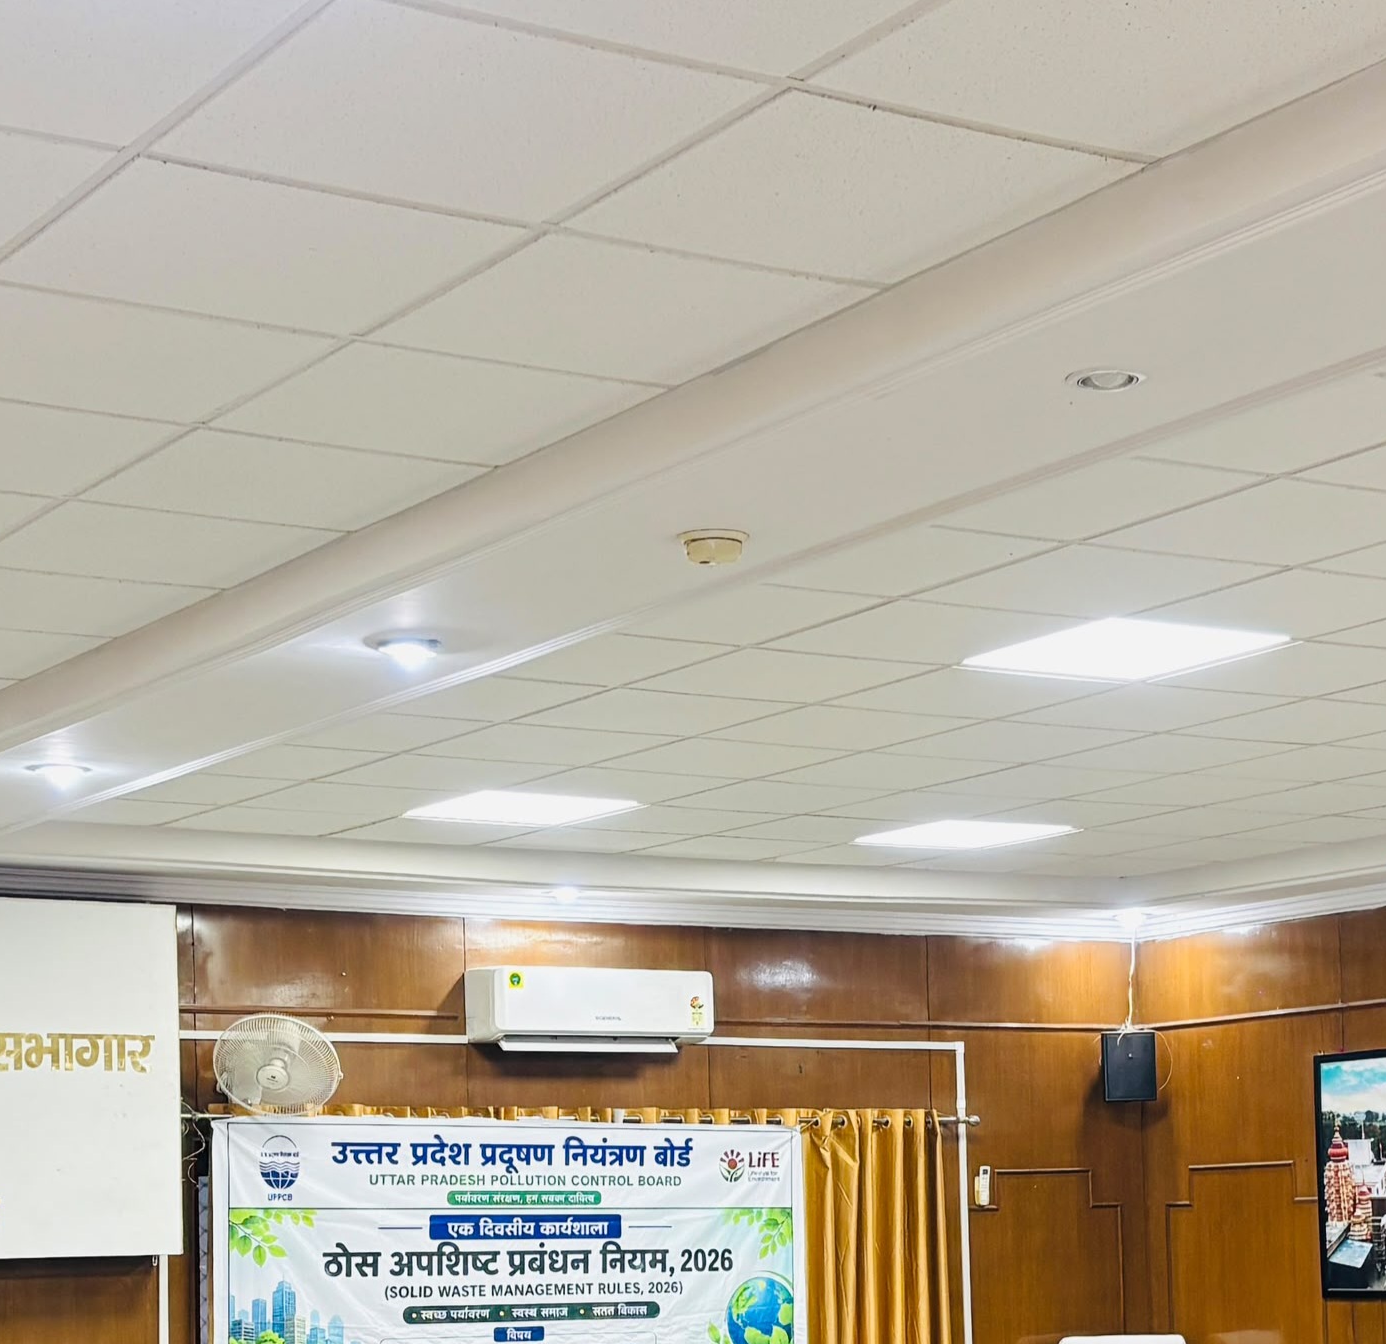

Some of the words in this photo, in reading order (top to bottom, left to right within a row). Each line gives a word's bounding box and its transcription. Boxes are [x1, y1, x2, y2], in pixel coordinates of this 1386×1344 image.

[331, 1141, 401, 1165] उत्तर
[410, 1134, 472, 1166] प्रदेश
[480, 1143, 555, 1174] प्रदूषण
[563, 1136, 647, 1167] नियंत्रण
[654, 1138, 693, 1168] बोर्ड
[369, 1174, 415, 1186] UTTAR
[421, 1174, 486, 1186] PRADESH
[491, 1174, 566, 1186] POLLUTION
[571, 1175, 634, 1187] CONTROL
[639, 1175, 682, 1187] BOARD
[447, 1221, 474, 1237] एक
[479, 1217, 535, 1237] दिवसीय
[539, 1218, 609, 1236] कार्यशाला
[323, 1243, 382, 1278] ठोस
[389, 1241, 500, 1276] अपशिष्ट
[506, 1242, 592, 1277] प्रबंधन
[600, 1240, 675, 1277] नियम,
[680, 1248, 734, 1272] 2026
[385, 1285, 433, 1301] (SOLID
[438, 1284, 486, 1298] WASTE
[491, 1282, 593, 1298] MANAGEMENT
[598, 1281, 644, 1296] RULES,
[648, 1280, 683, 1296] 2026)
[451, 1308, 490, 1319] पर्यावरण
[540, 1306, 568, 1317] समाज
